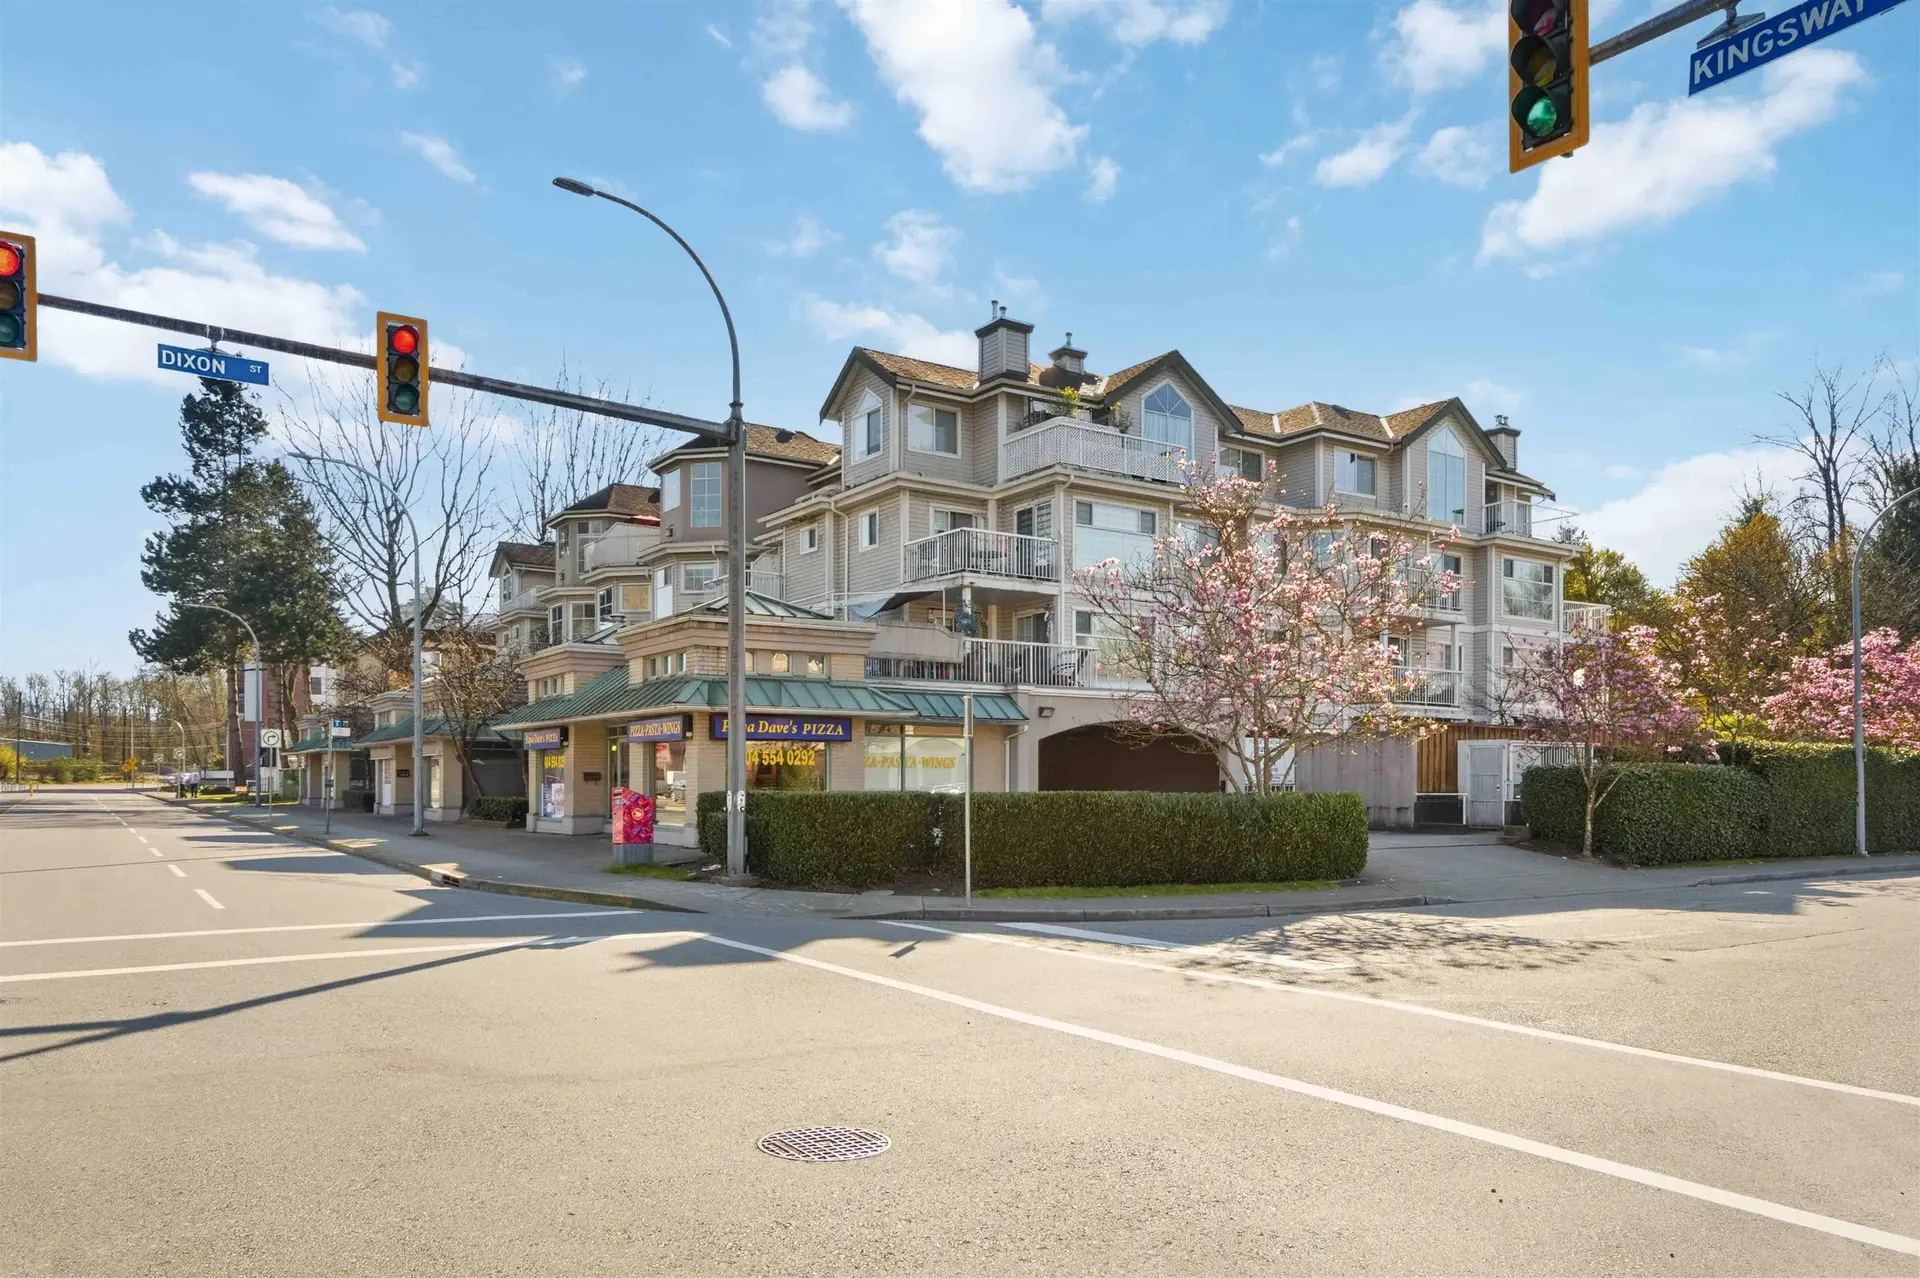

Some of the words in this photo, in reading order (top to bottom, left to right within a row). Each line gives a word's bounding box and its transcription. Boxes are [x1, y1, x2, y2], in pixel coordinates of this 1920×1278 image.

[162, 349, 226, 375] DIXON
[249, 364, 262, 374] ST
[721, 720, 754, 733] Pa
[758, 720, 797, 734] Dave's
[802, 724, 843, 735] PIZZA
[745, 749, 759, 765] 04
[762, 749, 784, 766] 554
[786, 749, 815, 766] 0292
